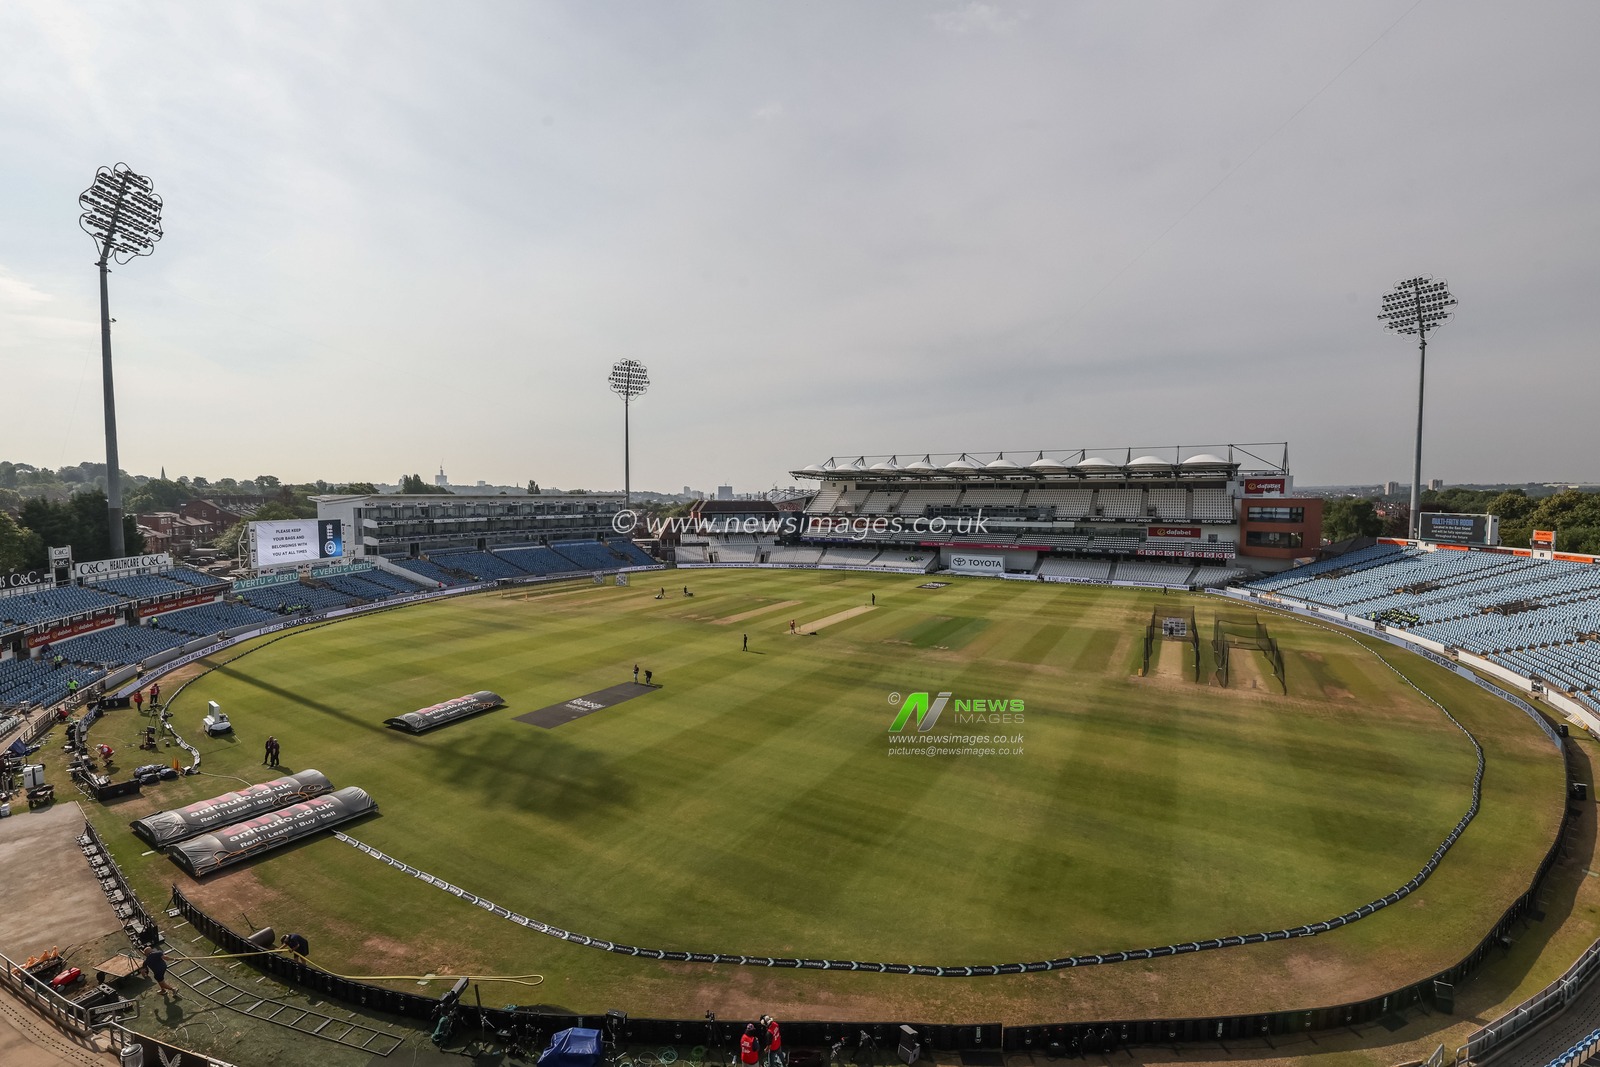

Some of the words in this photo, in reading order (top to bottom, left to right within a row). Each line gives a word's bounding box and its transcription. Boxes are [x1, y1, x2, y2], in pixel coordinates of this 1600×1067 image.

[80, 562, 107, 575] C&C.
[109, 558, 139, 570] HEALTHCARE
[141, 555, 166, 566] C&C.
[320, 567, 342, 575] VERTU
[349, 563, 372, 571] VERTU
[968, 559, 1001, 567] TOYOTA
[10, 571, 40, 587] C&C.
[240, 578, 265, 588] VERTU
[274, 572, 298, 582] VERTU
[283, 619, 306, 628] ENGLAND
[168, 654, 190, 670] BEHAVIOUR
[190, 651, 201, 660] WILL
[215, 638, 236, 650] TOLERATED
[1423, 649, 1440, 664] ENGLAND
[1440, 658, 1458, 672] CRICKET
[1475, 677, 1507, 698] DISCRIMINATORY
[1506, 693, 1528, 710] BEHAVIOUR
[190, 782, 292, 817] amtauto.co.uk
[200, 813, 222, 823] Rent
[226, 803, 252, 814] Lease
[257, 796, 273, 805] Buy
[229, 802, 335, 842] amtauto.co.uk
[239, 836, 262, 848] Rent
[267, 825, 293, 838] Lease
[299, 817, 316, 827] Buy
